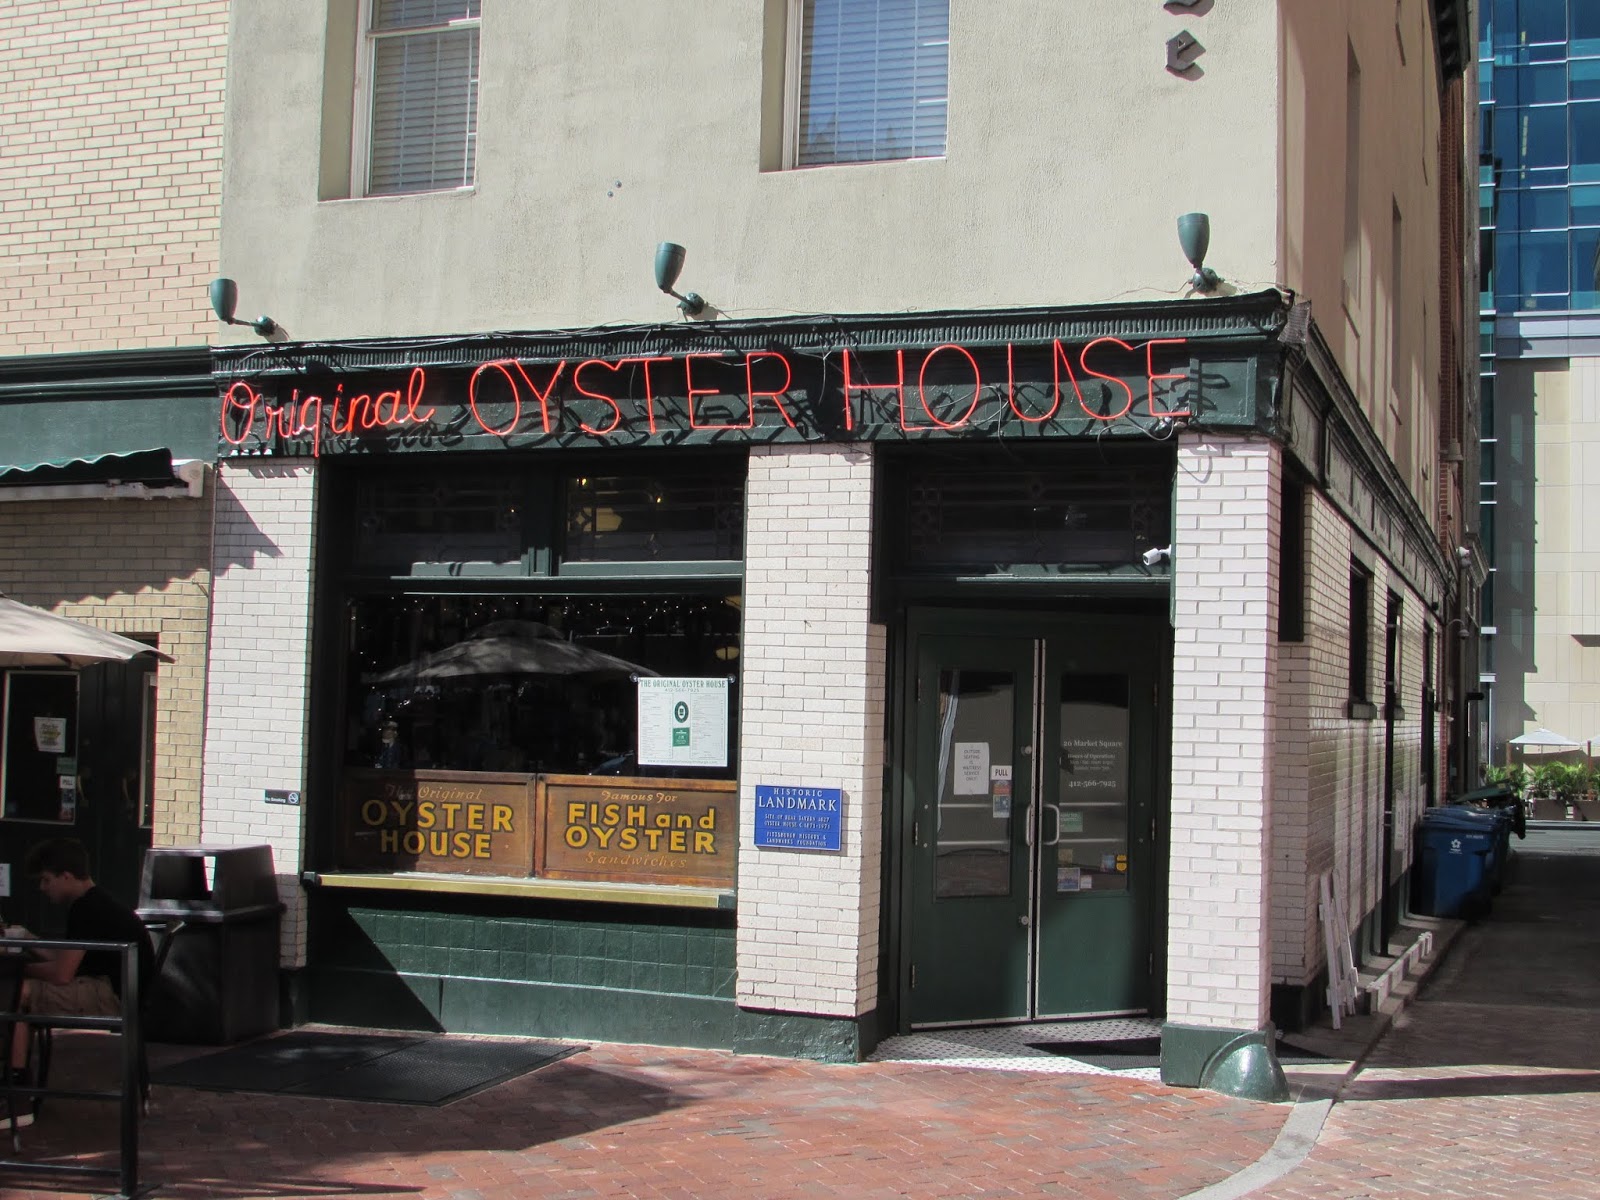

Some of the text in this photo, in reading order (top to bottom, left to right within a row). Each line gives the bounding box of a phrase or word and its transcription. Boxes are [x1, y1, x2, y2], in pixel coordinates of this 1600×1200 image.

[219, 337, 1192, 458] Original OYSTER HOUSE
[640, 679, 726, 689] THE ORIGINAL OYSTER HOUSE
[1073, 739, 1098, 747] Market
[1099, 740, 1123, 748] Square
[1068, 780, 1116, 788] 412-566-7925
[417, 785, 485, 801] Original
[601, 789, 679, 804] Famous For
[773, 788, 824, 797] HISTORIC
[758, 796, 837, 811] LANDMARK
[361, 800, 514, 833] OYSTER
[568, 802, 716, 830] FISH and
[381, 829, 492, 859] HOUSE
[564, 825, 716, 854] OYSTER
[796, 839, 827, 847] FOUNDATION
[585, 850, 689, 869] Sandwiches
